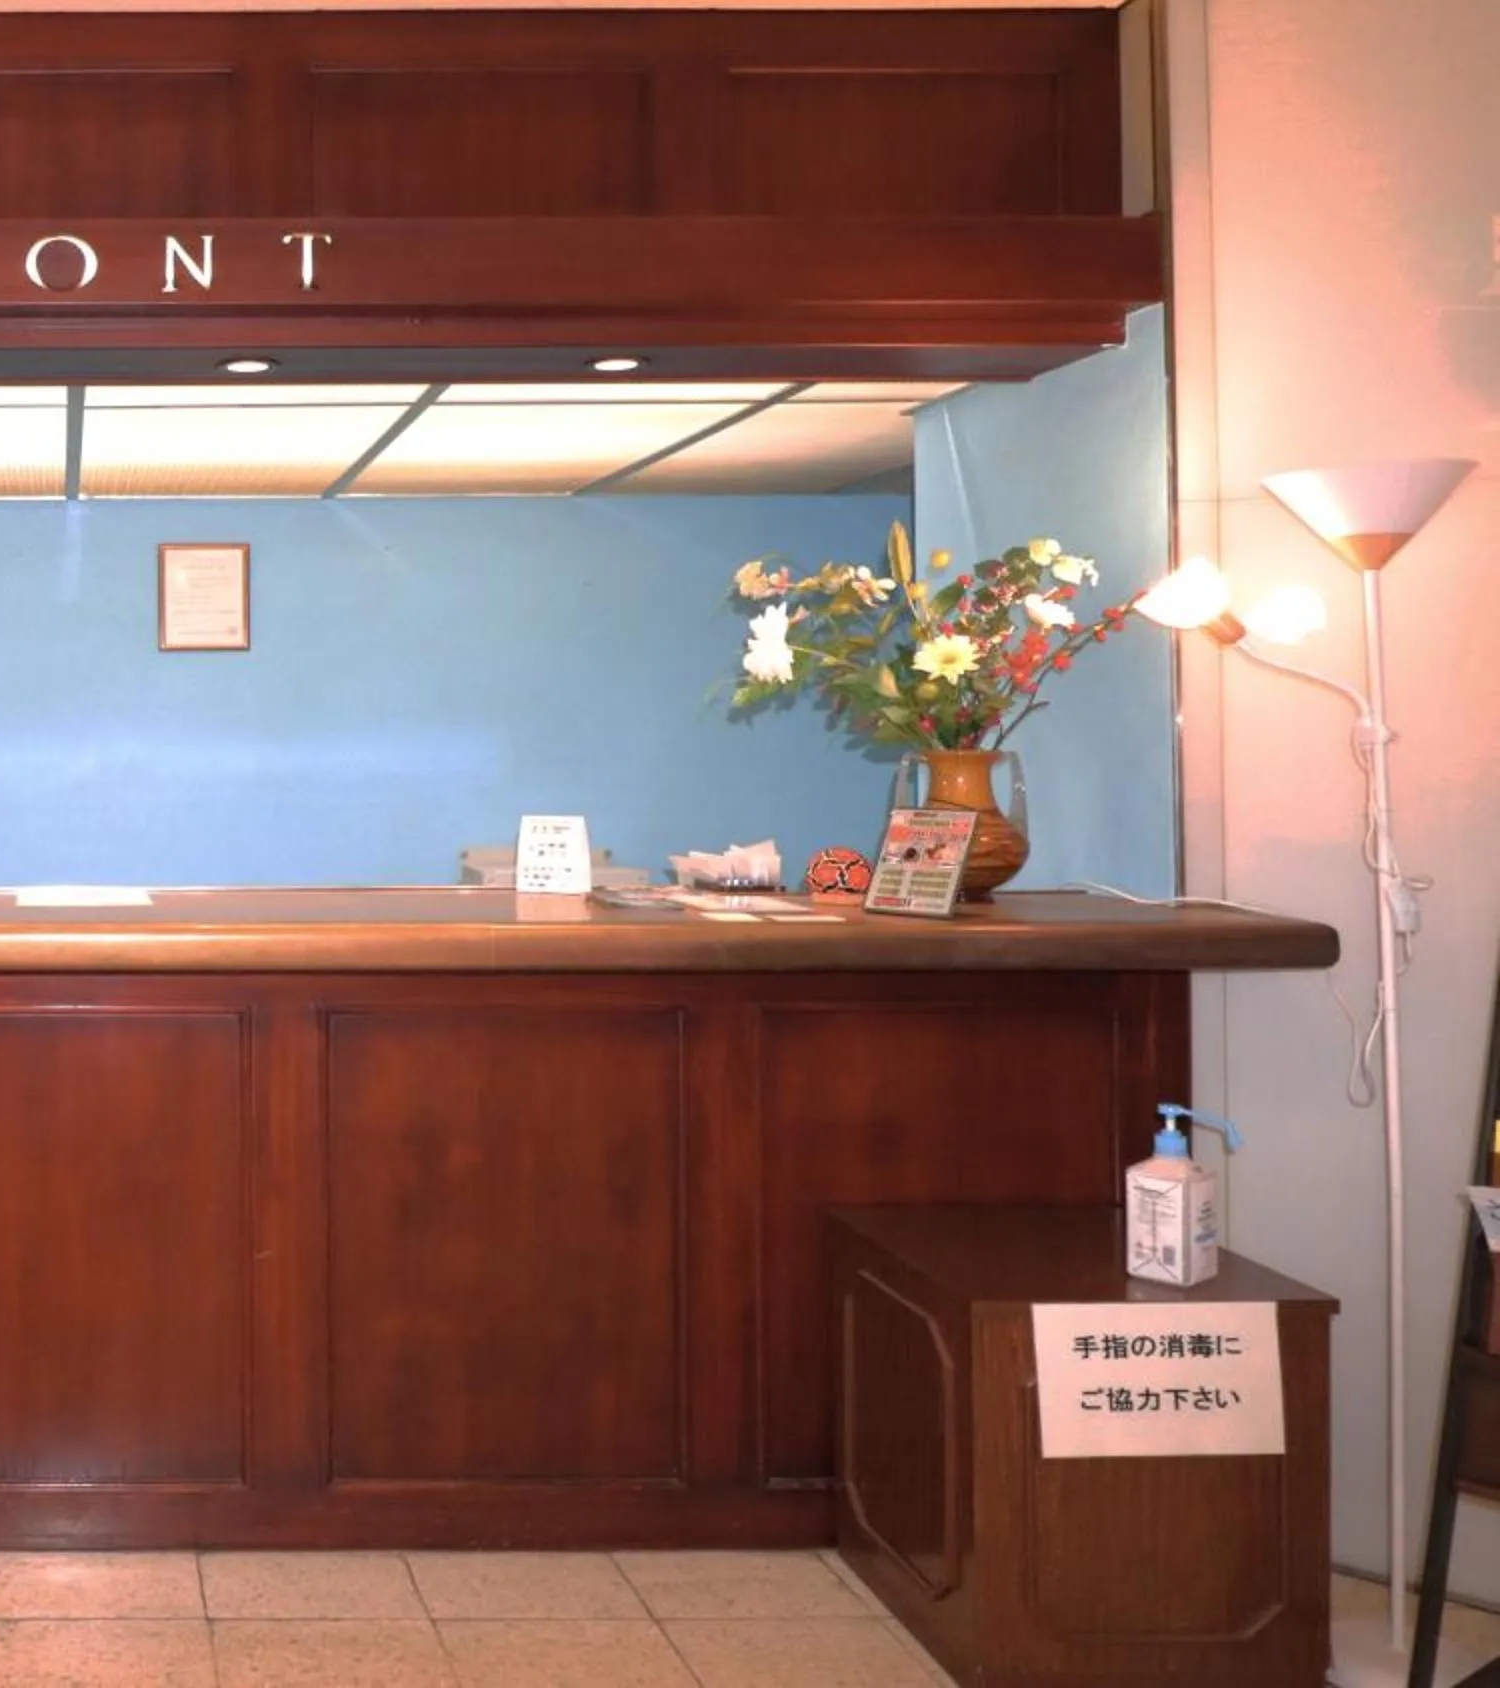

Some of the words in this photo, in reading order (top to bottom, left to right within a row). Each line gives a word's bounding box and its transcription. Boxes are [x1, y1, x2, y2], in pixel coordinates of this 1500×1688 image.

[1072, 1335, 1243, 1360] 手指の消毒に
[1080, 1387, 1241, 1412] ご協力下さい
